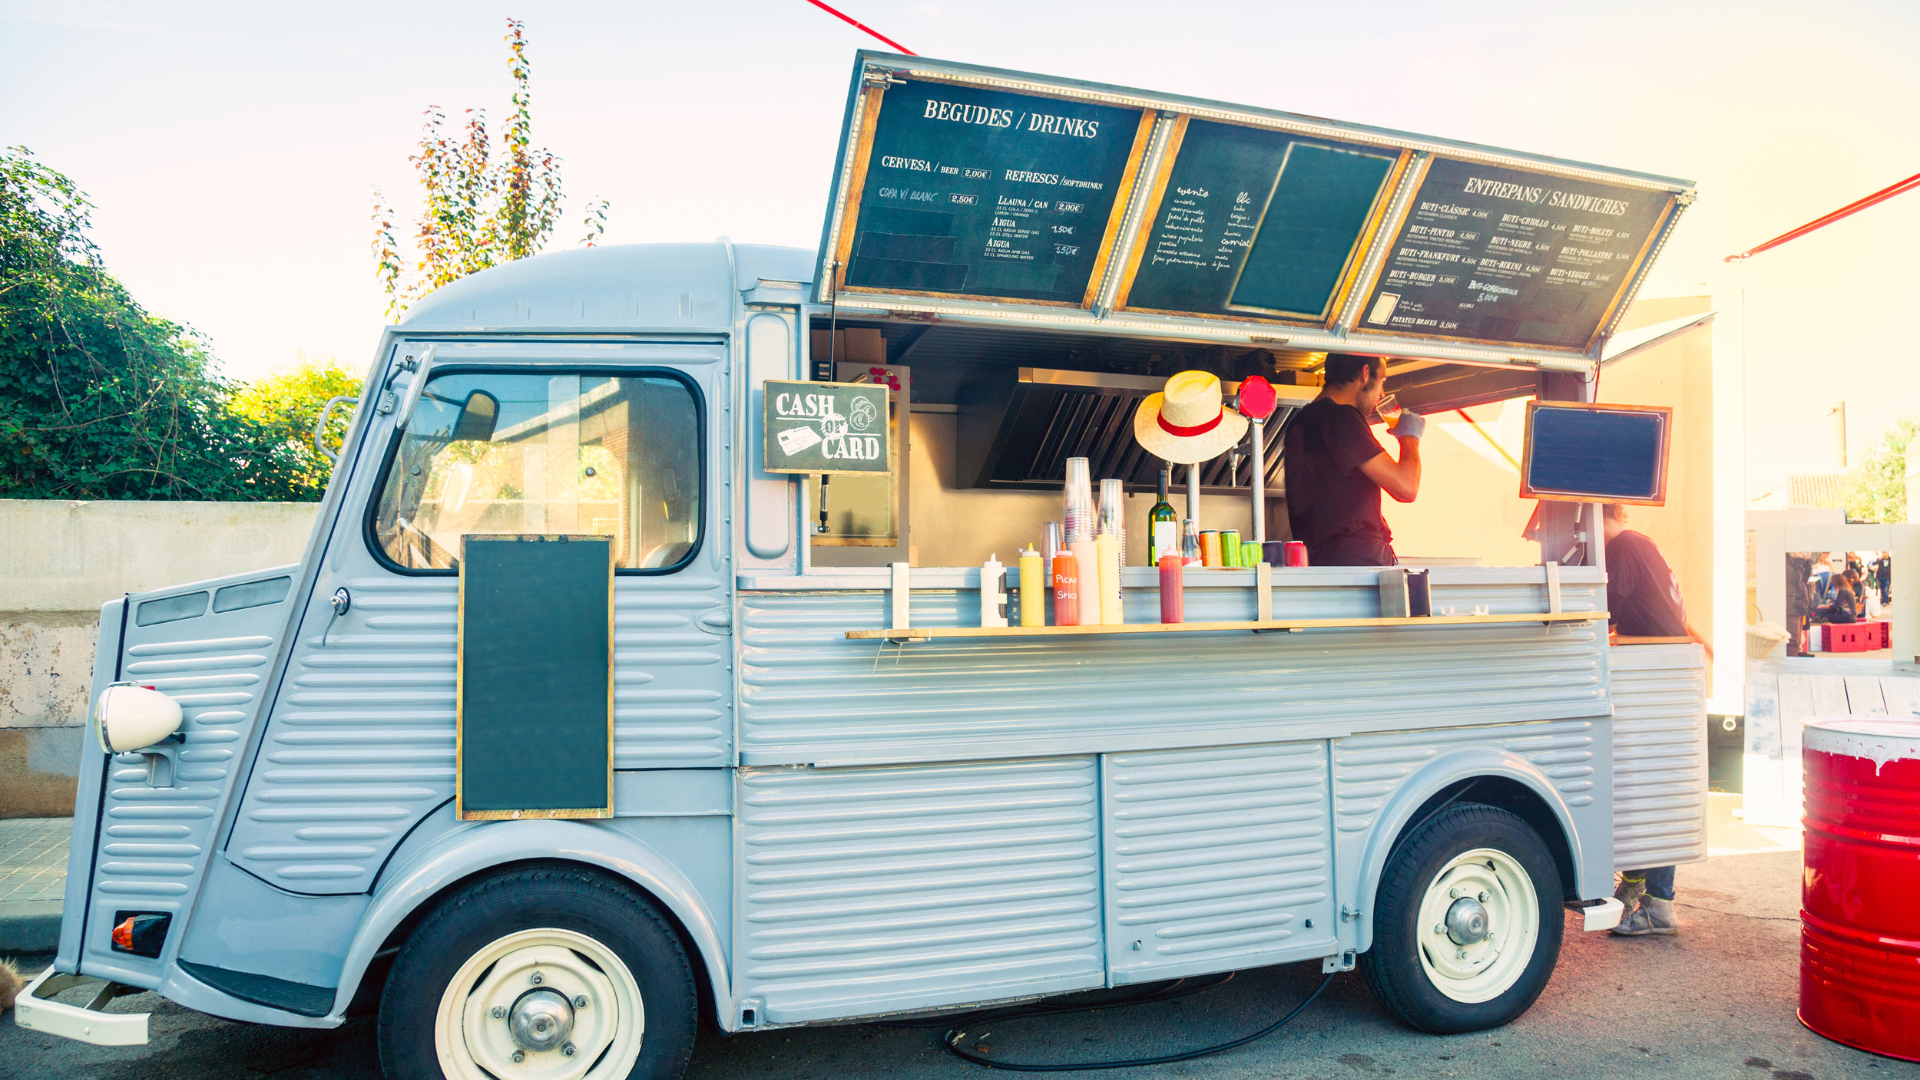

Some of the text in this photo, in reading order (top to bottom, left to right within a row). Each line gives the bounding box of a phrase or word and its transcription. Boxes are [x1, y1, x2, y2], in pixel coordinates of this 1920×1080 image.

[923, 99, 1013, 128] BEGUDES
[1028, 113, 1100, 139] DRINKS
[881, 155, 931, 172] CERVESA
[941, 165, 959, 175] BEER
[964, 169, 988, 179] 2,00€
[1005, 169, 1058, 185] REFRESCS
[879, 187, 897, 199] COPA
[910, 190, 938, 202] BLANC
[951, 195, 974, 204] 2,50€
[1177, 187, 1209, 198] events
[1463, 177, 1542, 203] ENTREPANS
[1549, 191, 1629, 216] SANDWICHES
[998, 195, 1026, 207] LLAUNA
[1034, 200, 1049, 209] CAN
[1058, 203, 1080, 212] 2,00€
[1391, 316, 1416, 325] PATATES
[1416, 318, 1438, 326] BRAVES
[1439, 321, 1459, 330] 3,50€
[775, 392, 835, 417] CASH
[821, 436, 880, 460] CARD
